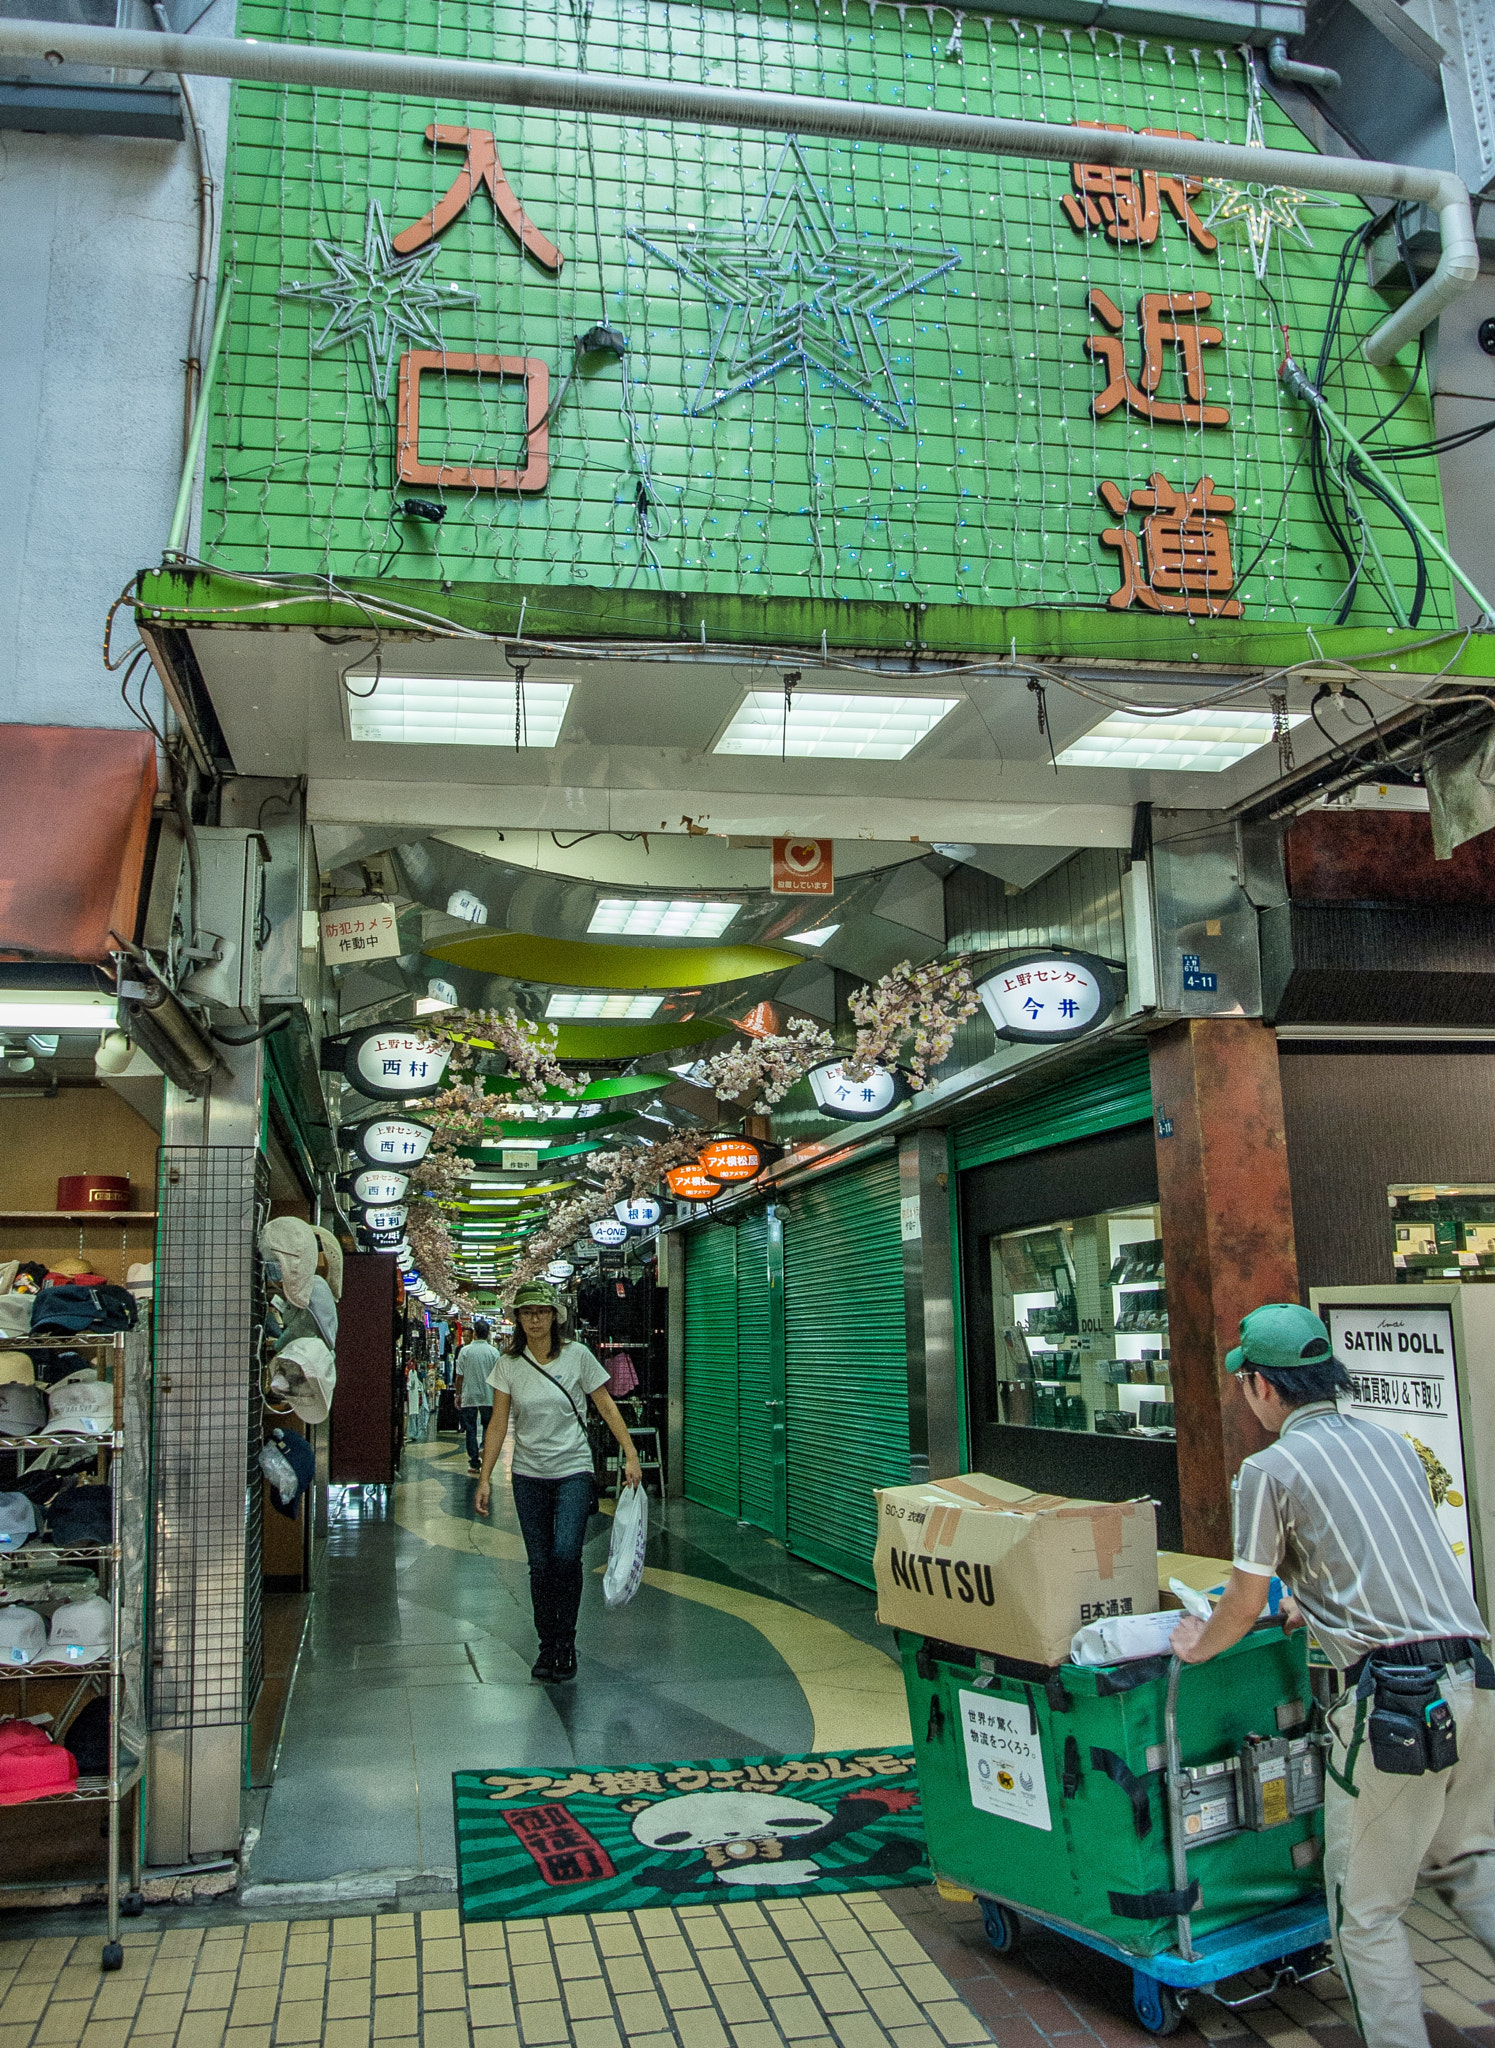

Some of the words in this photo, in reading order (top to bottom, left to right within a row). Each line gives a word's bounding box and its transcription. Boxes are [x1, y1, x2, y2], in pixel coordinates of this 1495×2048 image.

[394, 124, 563, 491] 入口
[326, 917, 393, 938] 防犯カメラ
[339, 935, 378, 952] 作動中
[1003, 970, 1088, 993] 上野センター
[1187, 976, 1213, 988] 4-11
[1022, 996, 1080, 1020] 今井
[374, 1039, 443, 1058] 上野センター
[382, 1059, 429, 1078] 西村
[834, 1085, 876, 1102] 今井
[376, 1126, 428, 1140] 上野センター
[380, 1140, 416, 1155] 西村
[715, 1144, 753, 1153] 上野センター
[707, 1155, 759, 1168] アメ横松屋
[365, 1174, 405, 1184] 上野センター
[674, 1175, 720, 1187] アメ横松
[368, 1185, 396, 1196] 西村
[375, 1217, 400, 1227] 甘利
[628, 1208, 653, 1220] 根津
[595, 1227, 626, 1236] A-ONE
[1081, 1318, 1103, 1332] DOLL
[1344, 1330, 1393, 1352] SATIN
[1397, 1332, 1444, 1355] DOLL
[885, 1504, 906, 1519] SC-3
[908, 1511, 927, 1525] 衣類
[890, 1546, 995, 1607] NITTSU
[1081, 1597, 1133, 1620] 日本通運
[968, 1709, 1018, 1734] 世界が驚く、
[970, 1729, 1036, 1759] 物流をつくろう。
